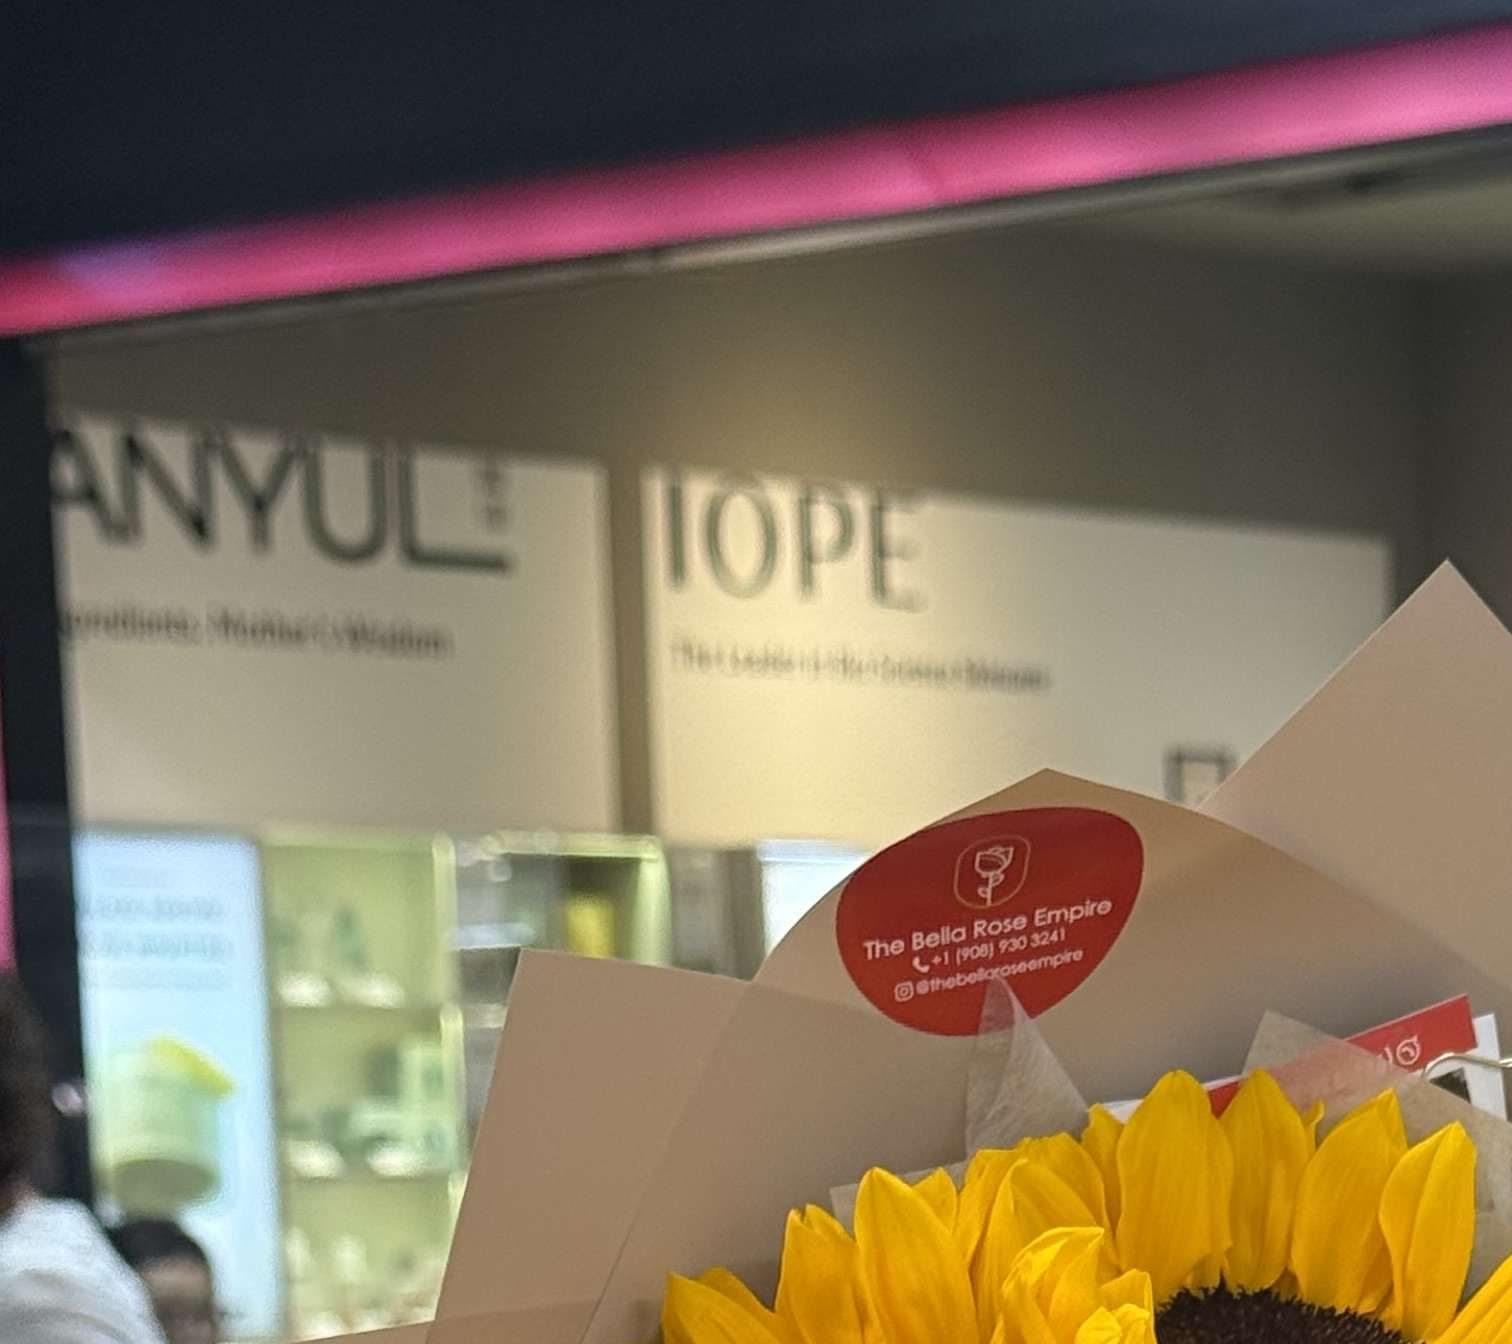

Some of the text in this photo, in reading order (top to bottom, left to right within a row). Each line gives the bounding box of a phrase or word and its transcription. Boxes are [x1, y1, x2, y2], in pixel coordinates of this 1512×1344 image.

[662, 466, 930, 613] IOPE
[863, 897, 1114, 961] The Bella Rose Empire
[932, 950, 949, 966] +1
[999, 935, 1028, 953] 930
[1031, 928, 1066, 948] 3241
